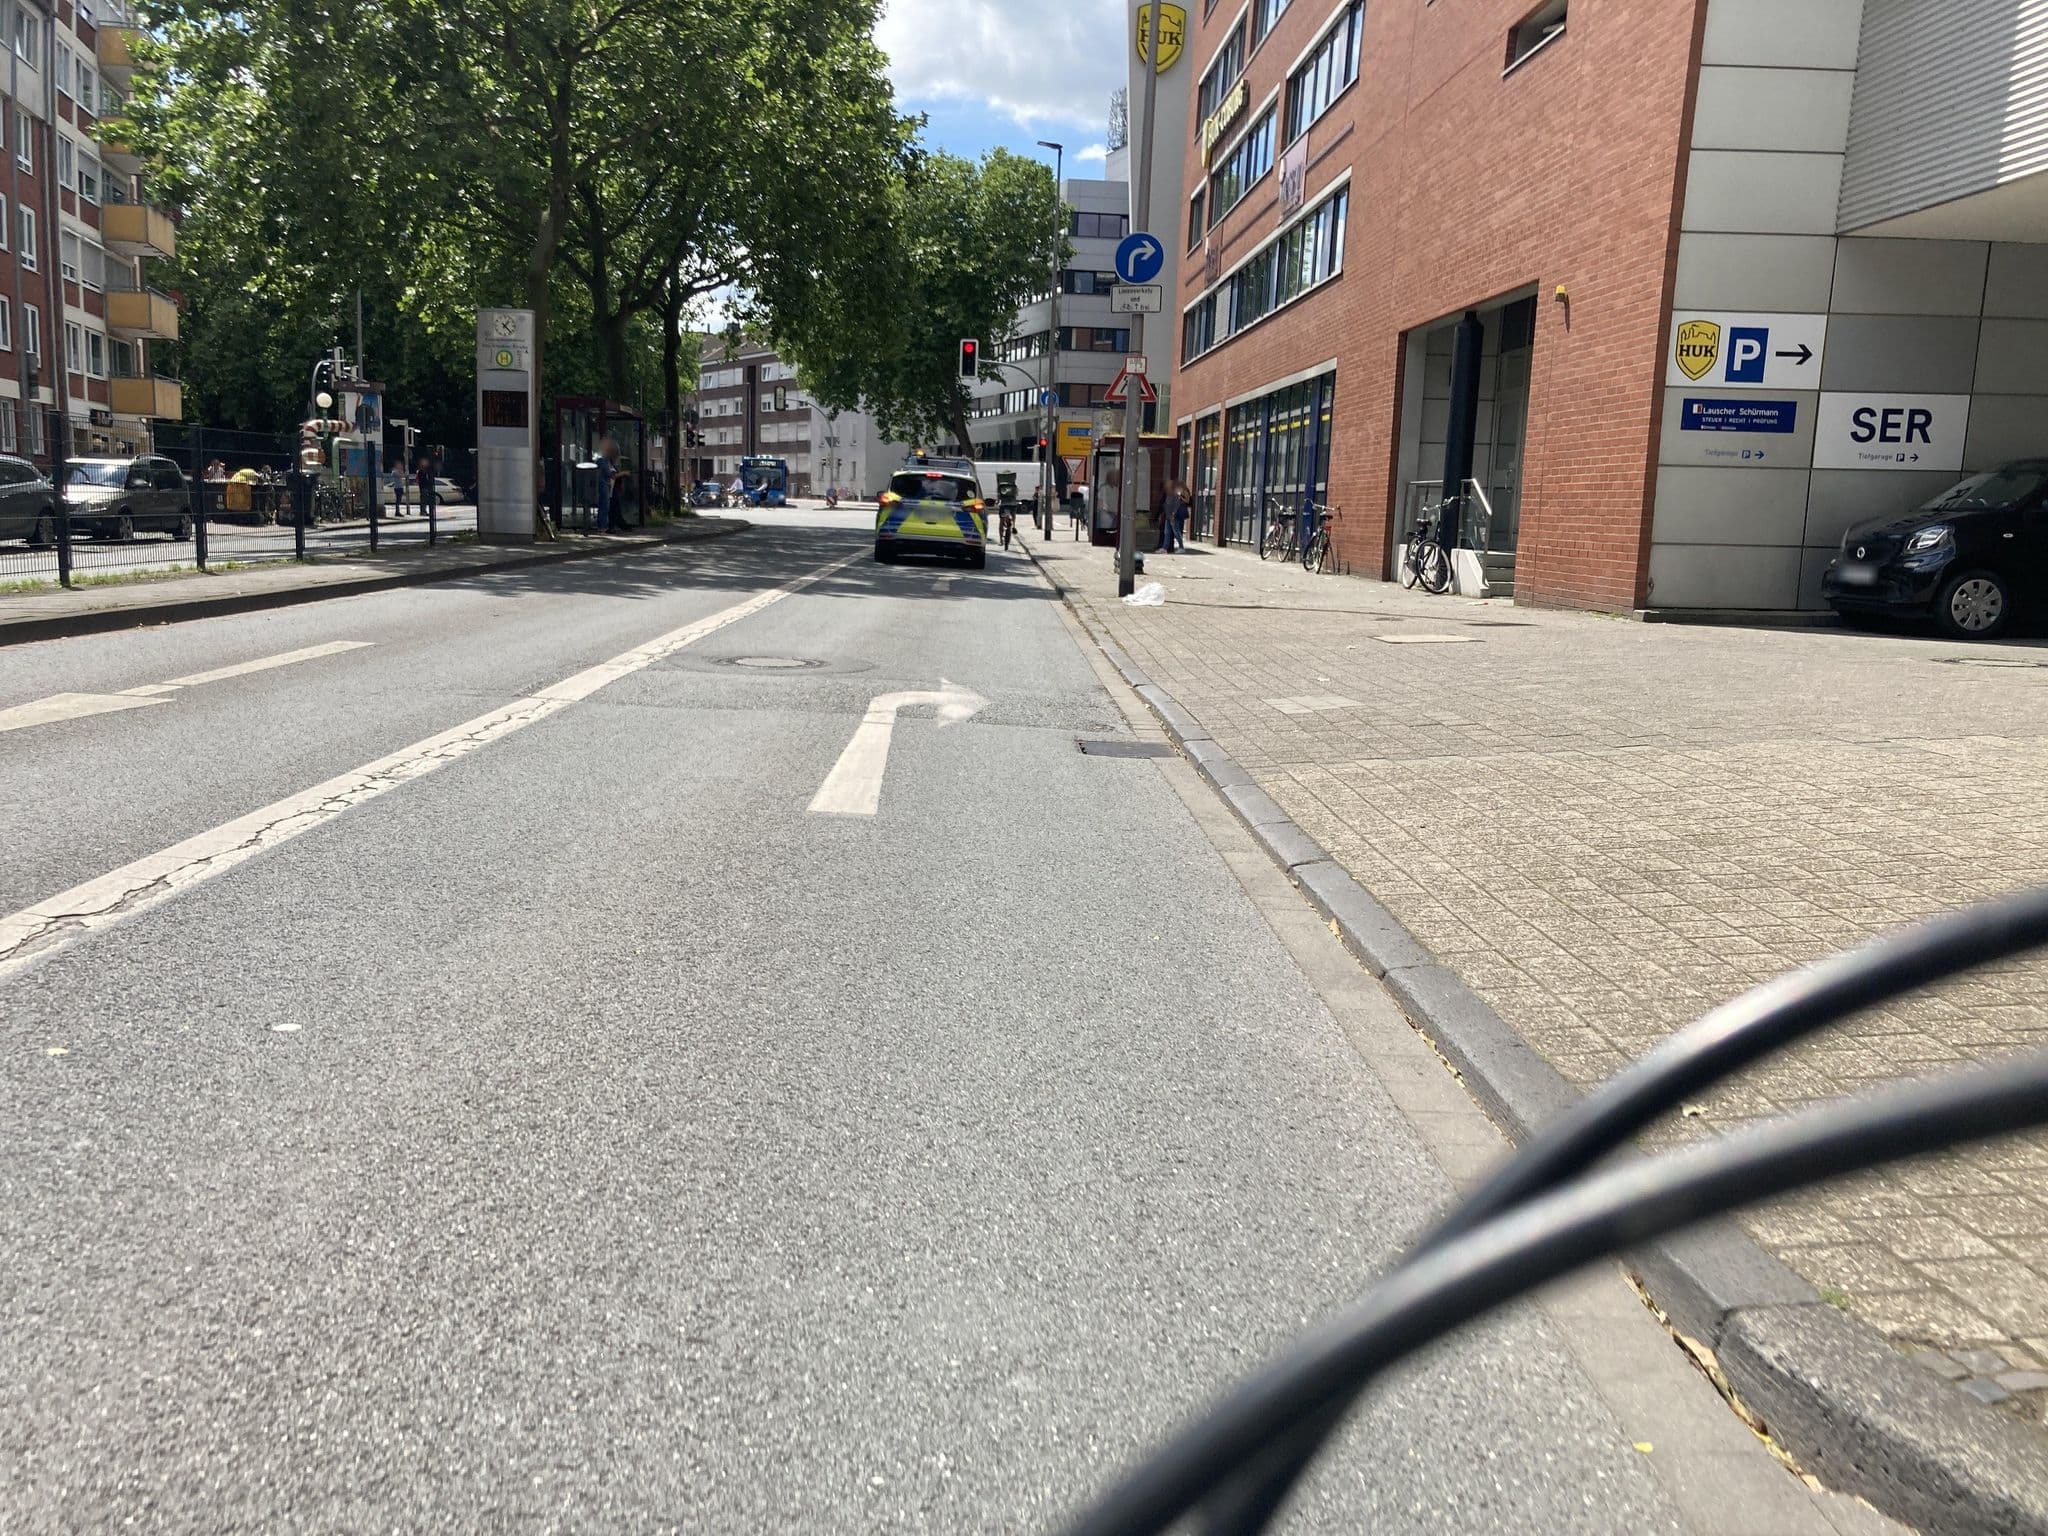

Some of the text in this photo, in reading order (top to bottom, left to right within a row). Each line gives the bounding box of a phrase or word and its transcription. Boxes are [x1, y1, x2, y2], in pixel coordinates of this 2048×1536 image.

[1679, 344, 1716, 358] HUK
[1733, 338, 1761, 372] P
[1703, 407, 1779, 417] Lauscher Schürmann
[1850, 407, 1932, 444] SER
